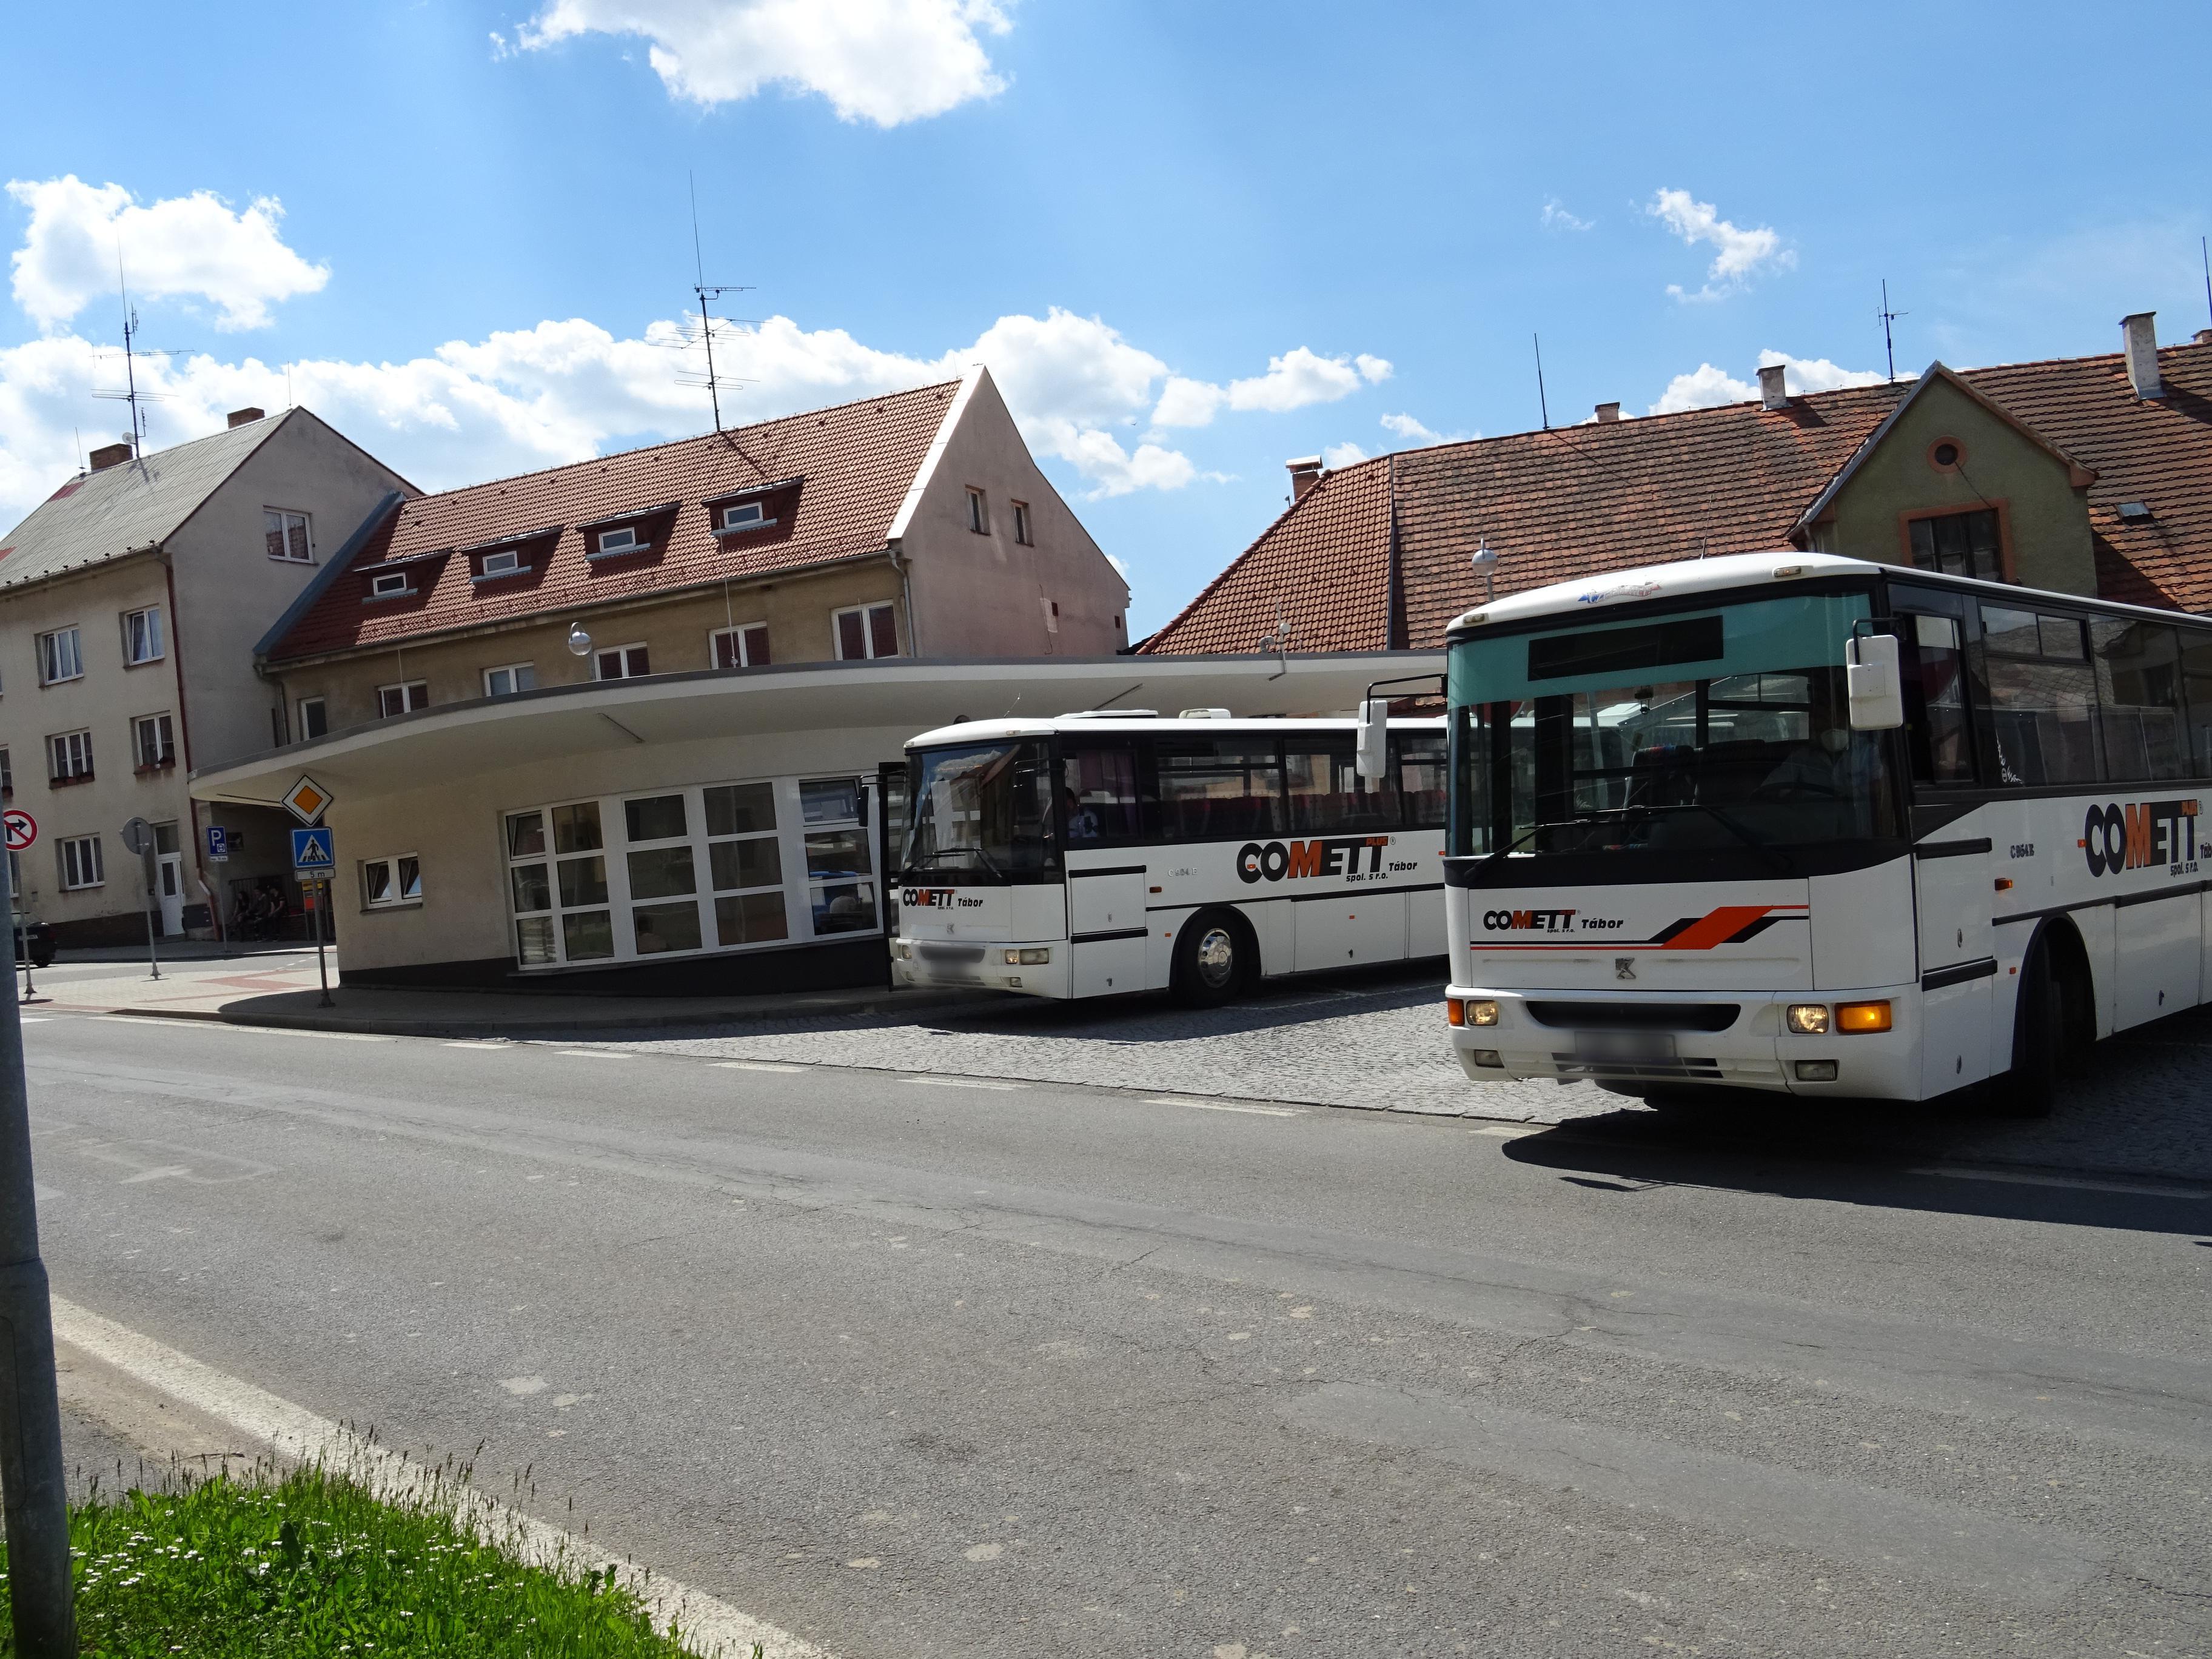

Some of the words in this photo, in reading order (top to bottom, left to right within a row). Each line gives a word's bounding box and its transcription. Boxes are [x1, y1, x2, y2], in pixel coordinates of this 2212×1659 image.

[211, 830, 221, 846] P
[1366, 837, 1387, 846] PLUS
[2085, 799, 2197, 877] COMETT
[1236, 836, 1389, 883] COMETT
[1389, 861, 1418, 871] Tábor
[1346, 873, 1366, 882] spol.
[2170, 862, 2184, 877] spol.
[903, 889, 955, 907] COMETT
[958, 897, 984, 907] Tábor
[1483, 910, 1576, 931] COMETT
[1581, 918, 1624, 929] Tábor
